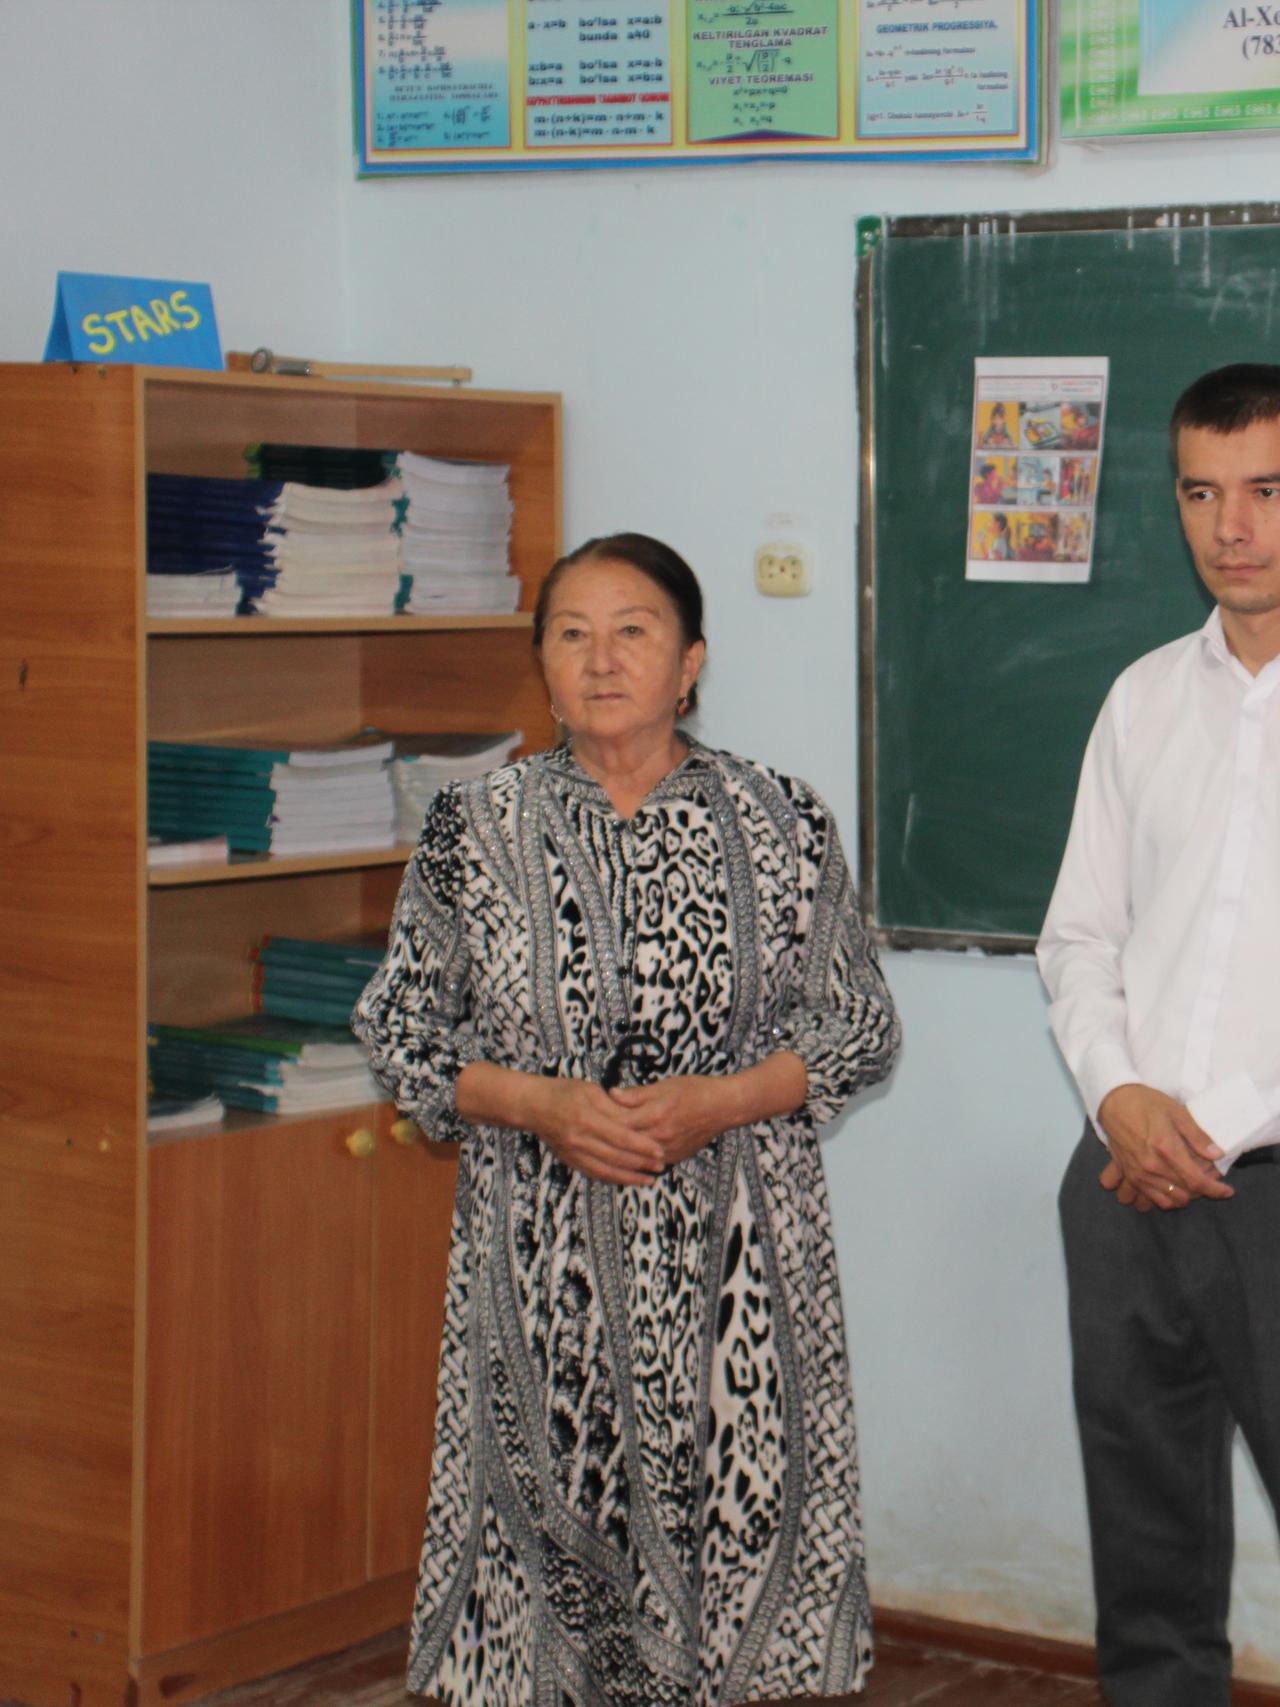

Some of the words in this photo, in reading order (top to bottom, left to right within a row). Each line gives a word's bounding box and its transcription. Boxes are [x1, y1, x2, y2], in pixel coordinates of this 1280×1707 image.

[693, 29, 769, 40] KELTIRILGAN
[774, 26, 828, 37] KVADRAT
[729, 39, 792, 49] TENGLAMA
[83, 291, 200, 354] STARS
